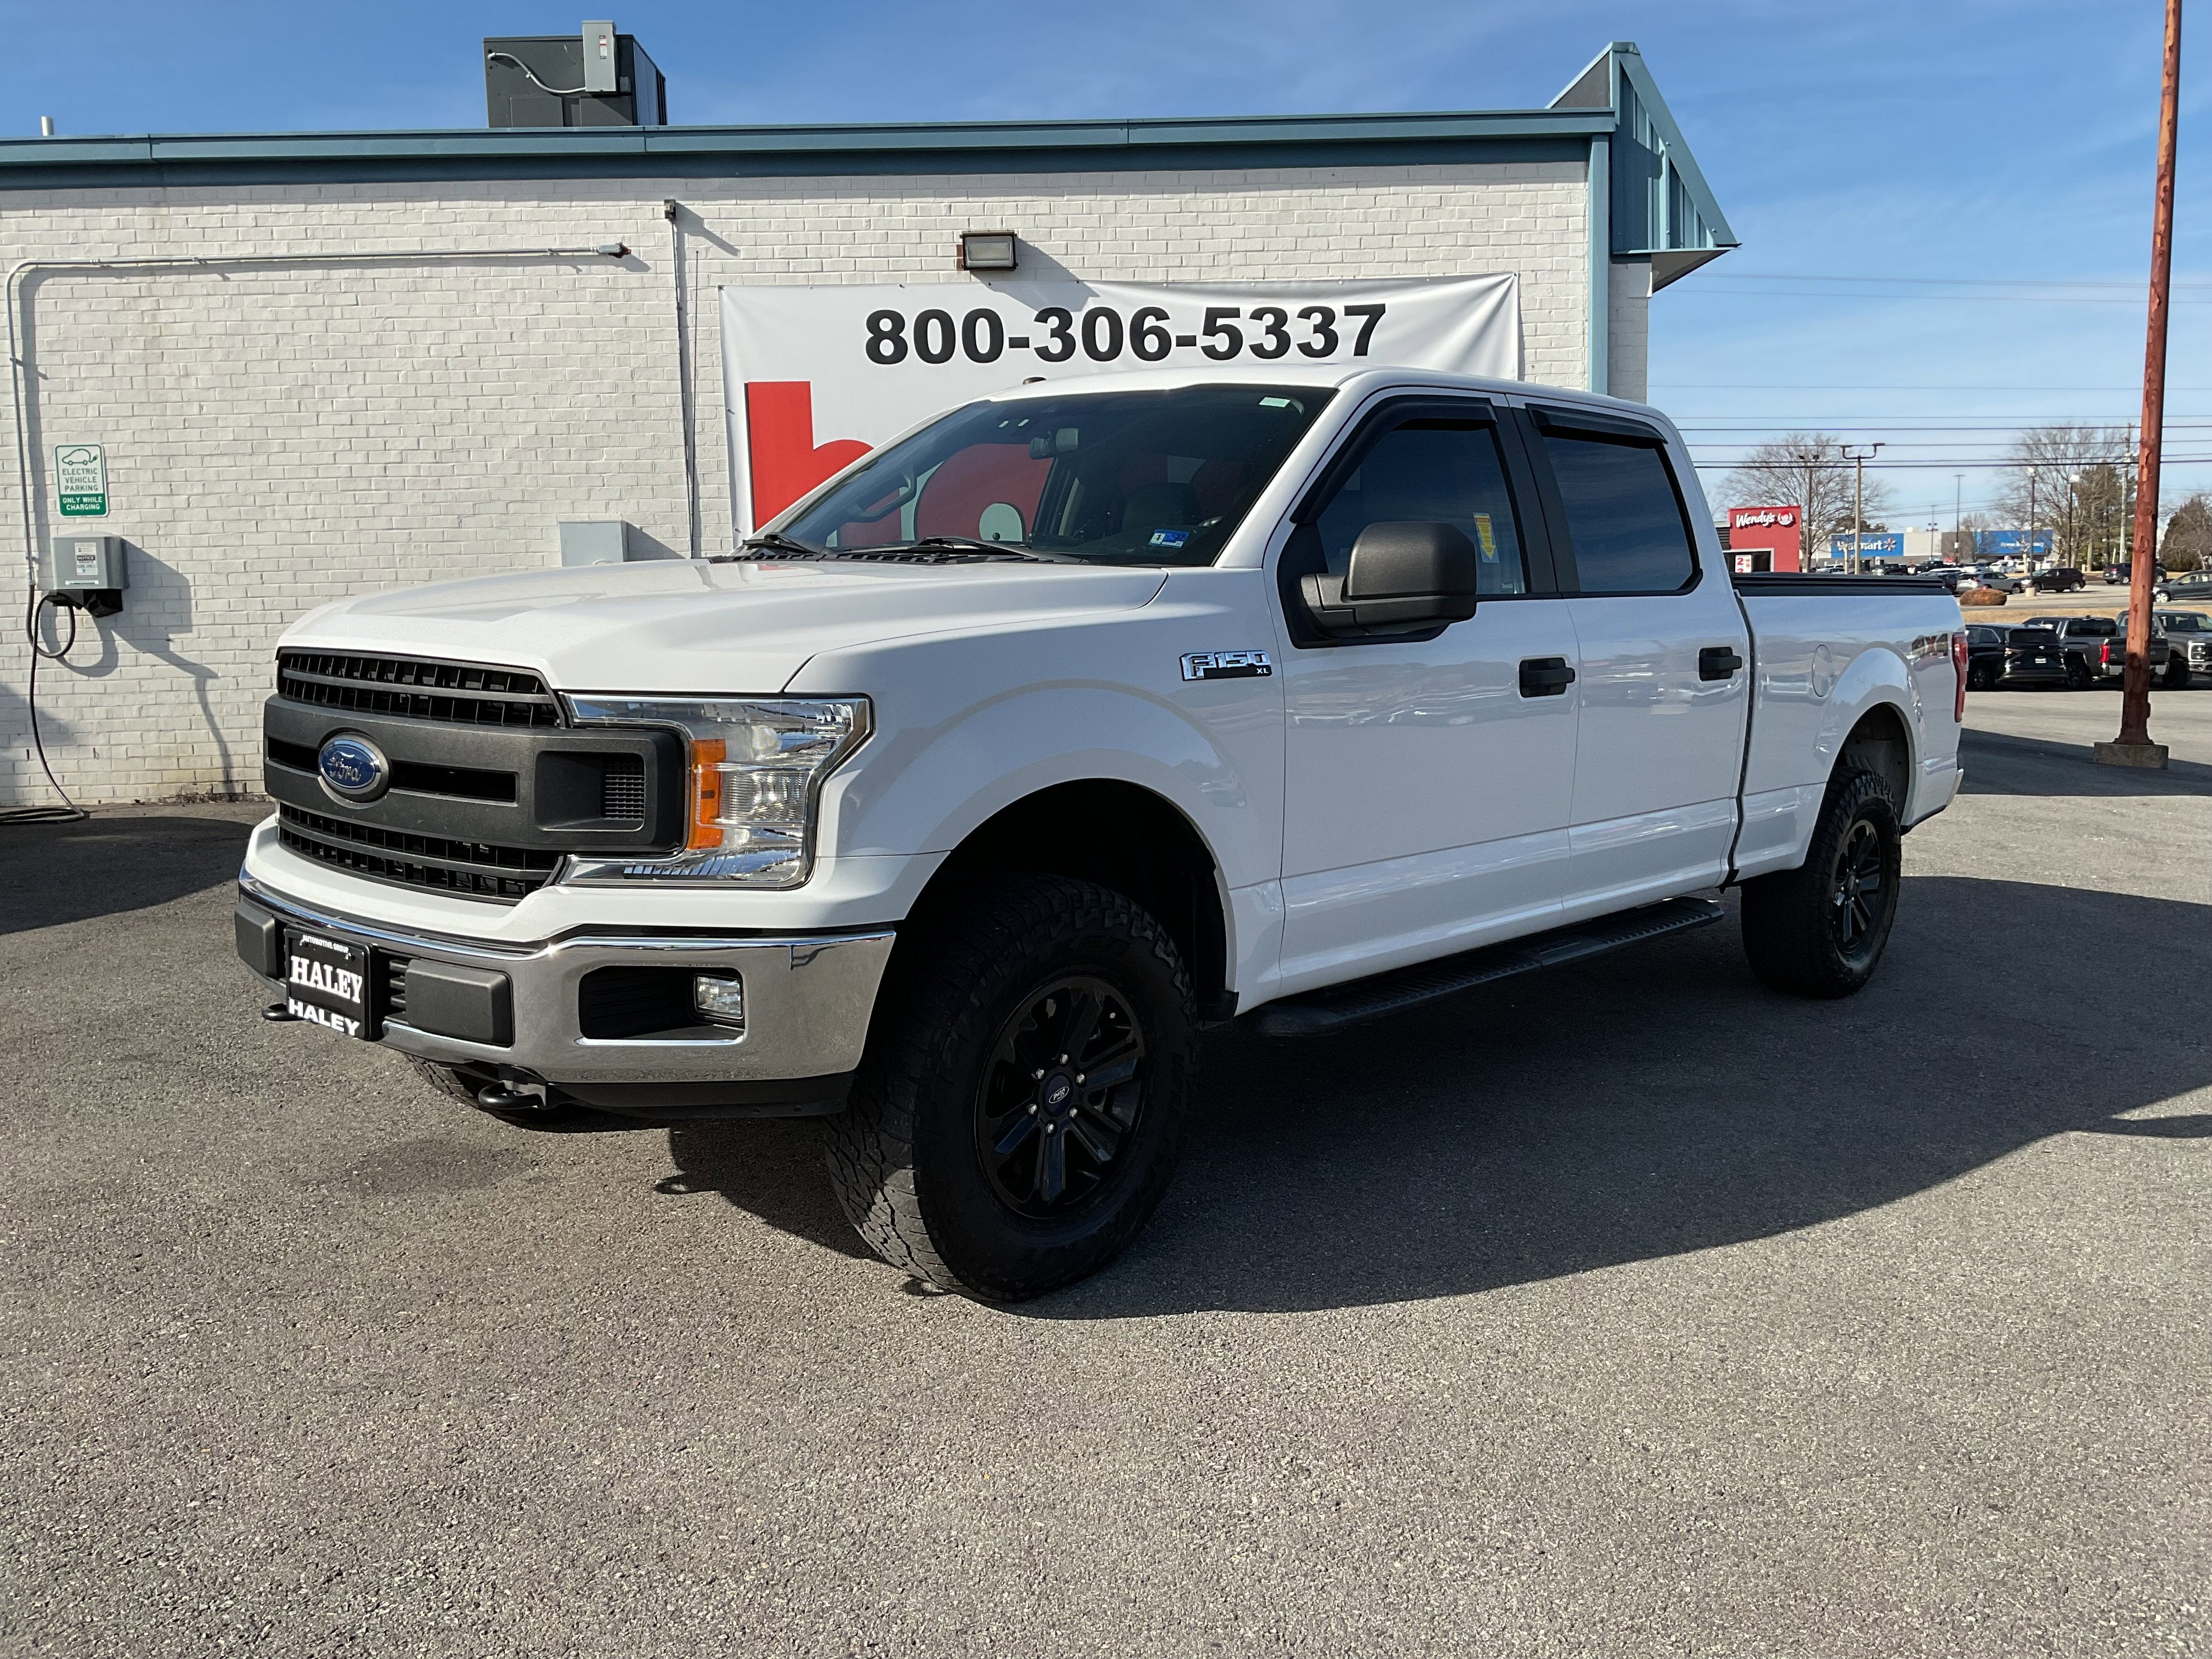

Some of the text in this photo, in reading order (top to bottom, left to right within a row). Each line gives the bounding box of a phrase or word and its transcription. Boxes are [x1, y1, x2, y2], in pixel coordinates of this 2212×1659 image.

[866, 304, 1386, 364] 800-306-5337
[1736, 510, 1775, 528] Wendy's
[1737, 557, 1744, 566] 2
[302, 934, 349, 953] AUTOMOTIVE GROUP
[290, 955, 363, 1003] HALEY
[289, 998, 360, 1036] HALEY
